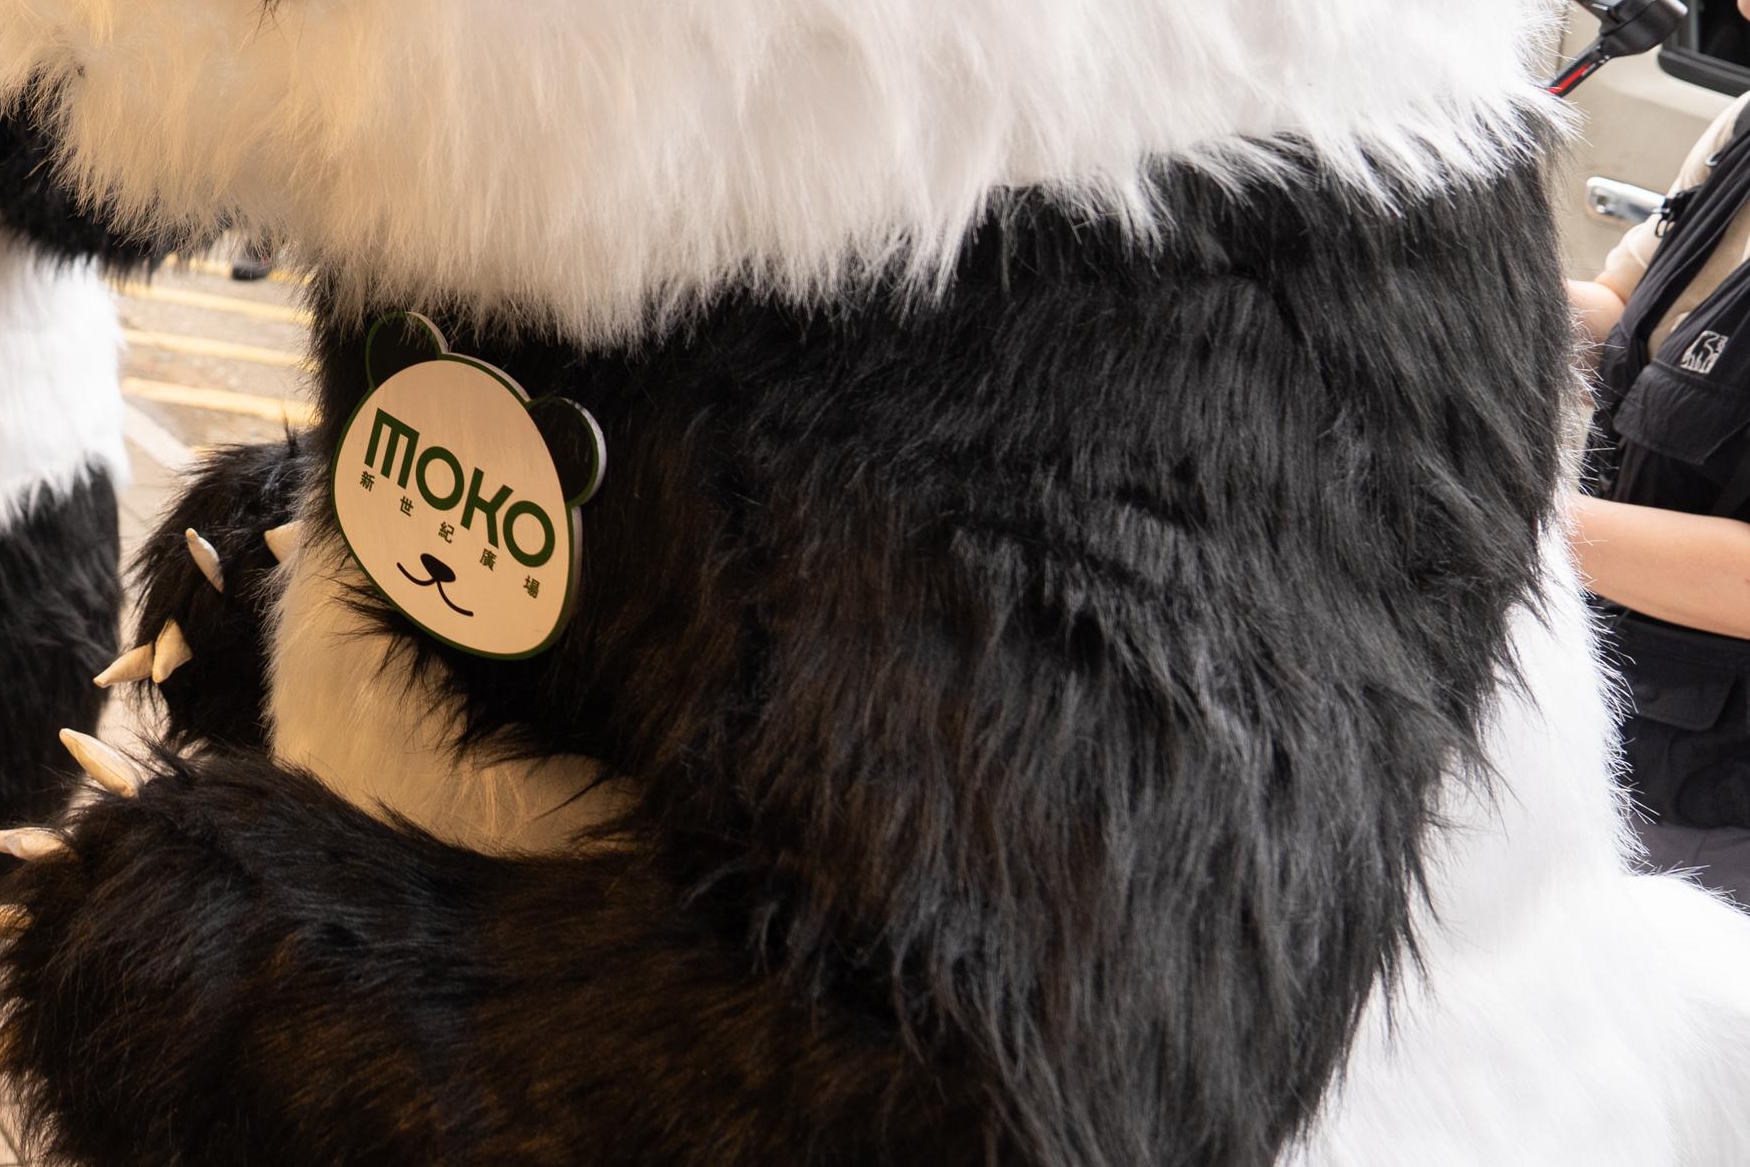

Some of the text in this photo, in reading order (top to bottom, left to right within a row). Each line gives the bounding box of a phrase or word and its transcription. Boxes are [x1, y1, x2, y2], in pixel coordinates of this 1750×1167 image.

[359, 471, 541, 599] 新世紀廣場
[363, 407, 556, 568] MOKO
